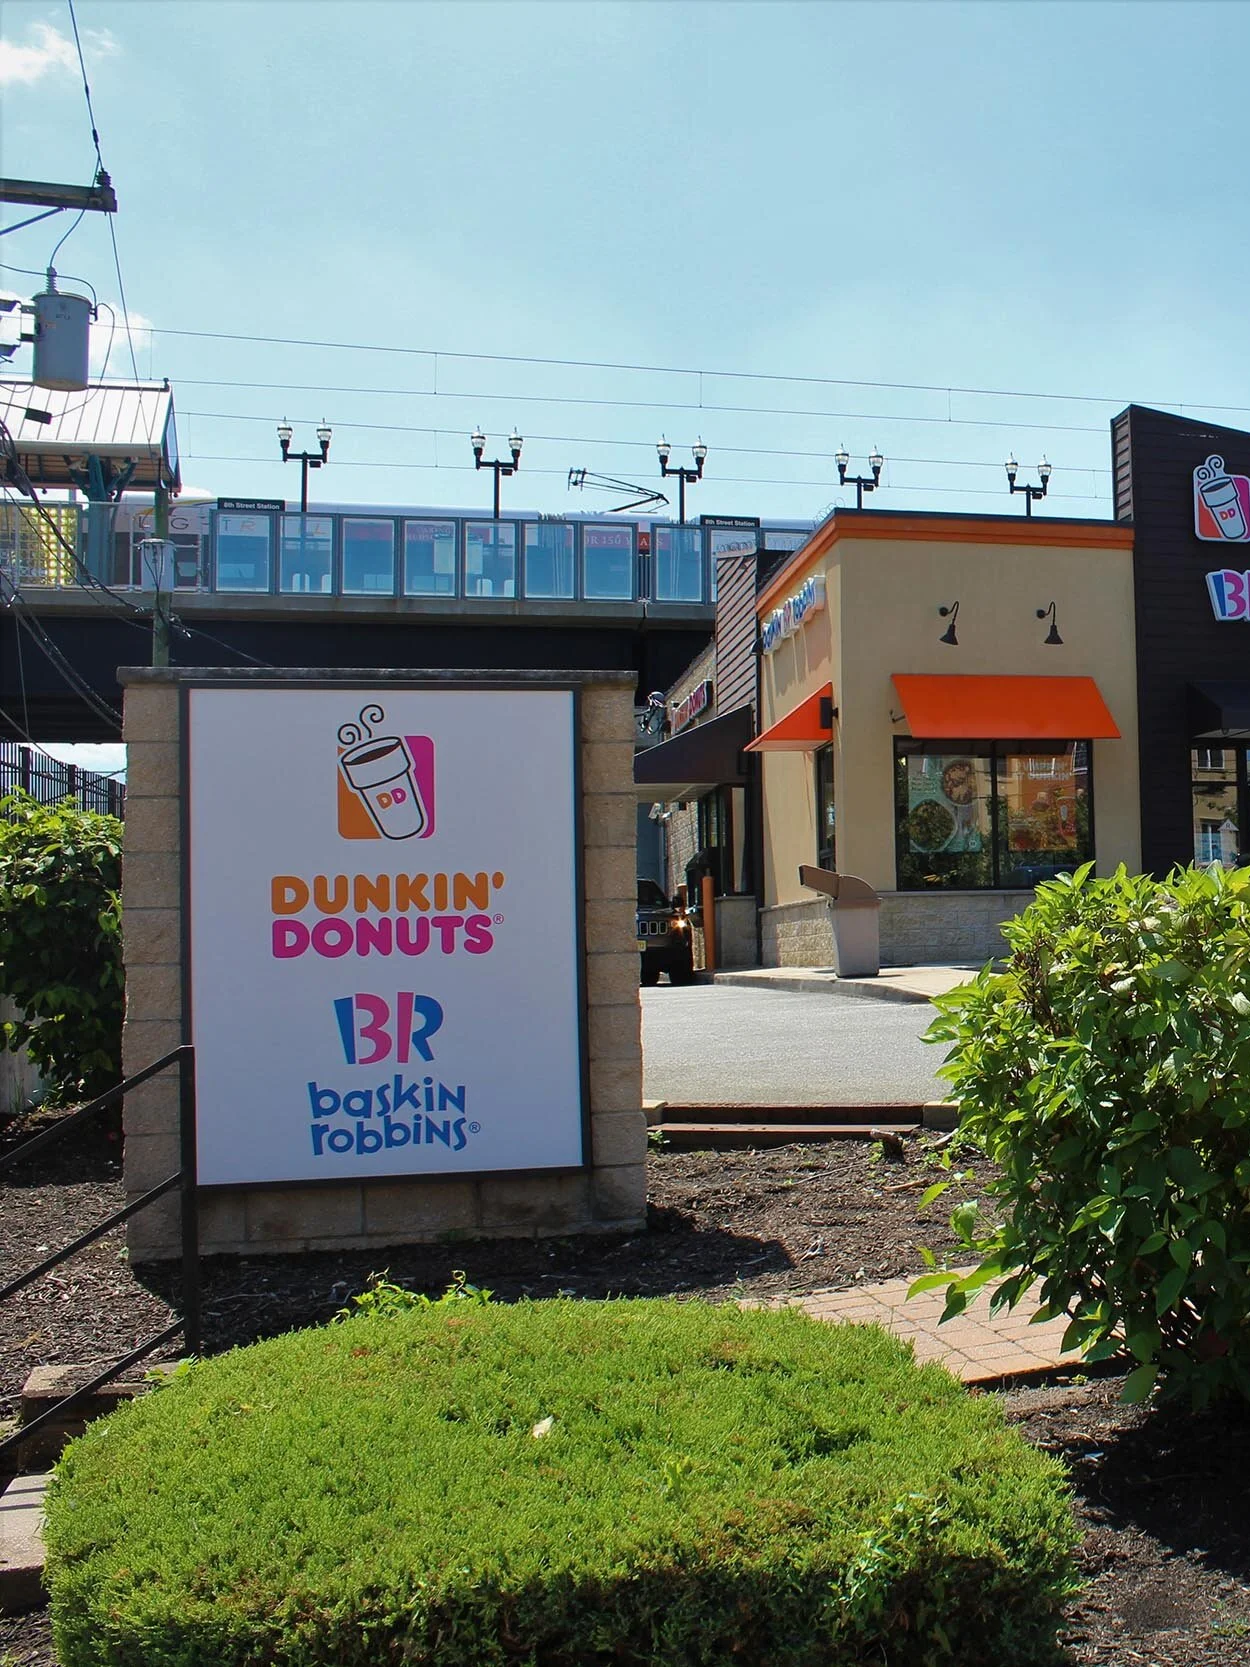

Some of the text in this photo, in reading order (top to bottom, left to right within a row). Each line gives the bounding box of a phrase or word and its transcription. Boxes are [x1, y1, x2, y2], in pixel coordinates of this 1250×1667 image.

[734, 520, 755, 528] Station
[375, 787, 407, 810] DD
[270, 870, 505, 915] DUNKIN'
[333, 991, 444, 1065] BR
